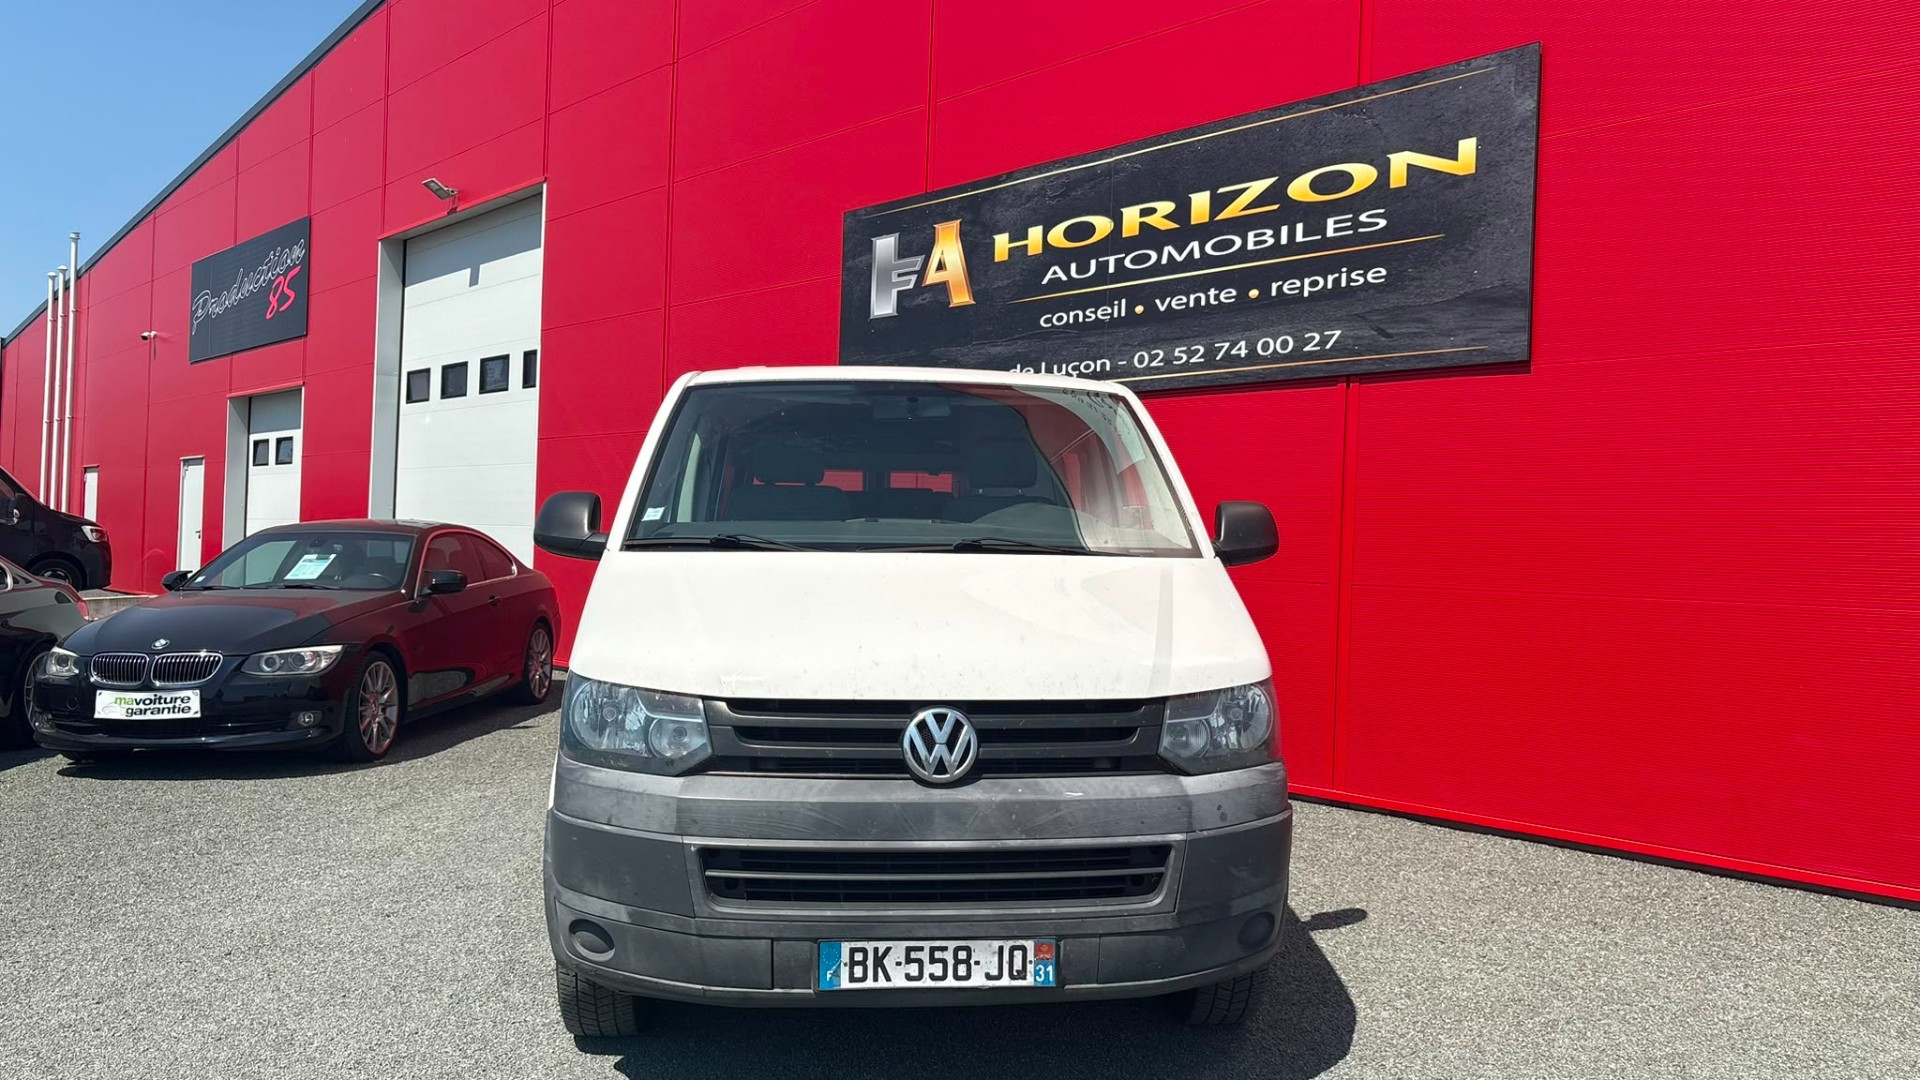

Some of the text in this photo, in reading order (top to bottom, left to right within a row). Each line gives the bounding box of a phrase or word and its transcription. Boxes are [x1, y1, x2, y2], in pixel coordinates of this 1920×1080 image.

[993, 136, 1478, 263] HORIZON
[1041, 208, 1389, 285] AUTOMOBILES
[192, 238, 306, 336] Production
[265, 265, 302, 320] 85
[1039, 265, 1388, 328] conseil vente reprise
[1133, 349, 1165, 369] 02
[1172, 345, 1205, 365] 52
[1214, 340, 1249, 361] 74
[1256, 335, 1294, 356] 00
[1302, 329, 1342, 352] 27
[114, 693, 191, 706] mavoiture
[125, 703, 192, 718] garantie
[848, 944, 1029, 983] BK-558-JQ
[1035, 965, 1054, 982] 31
